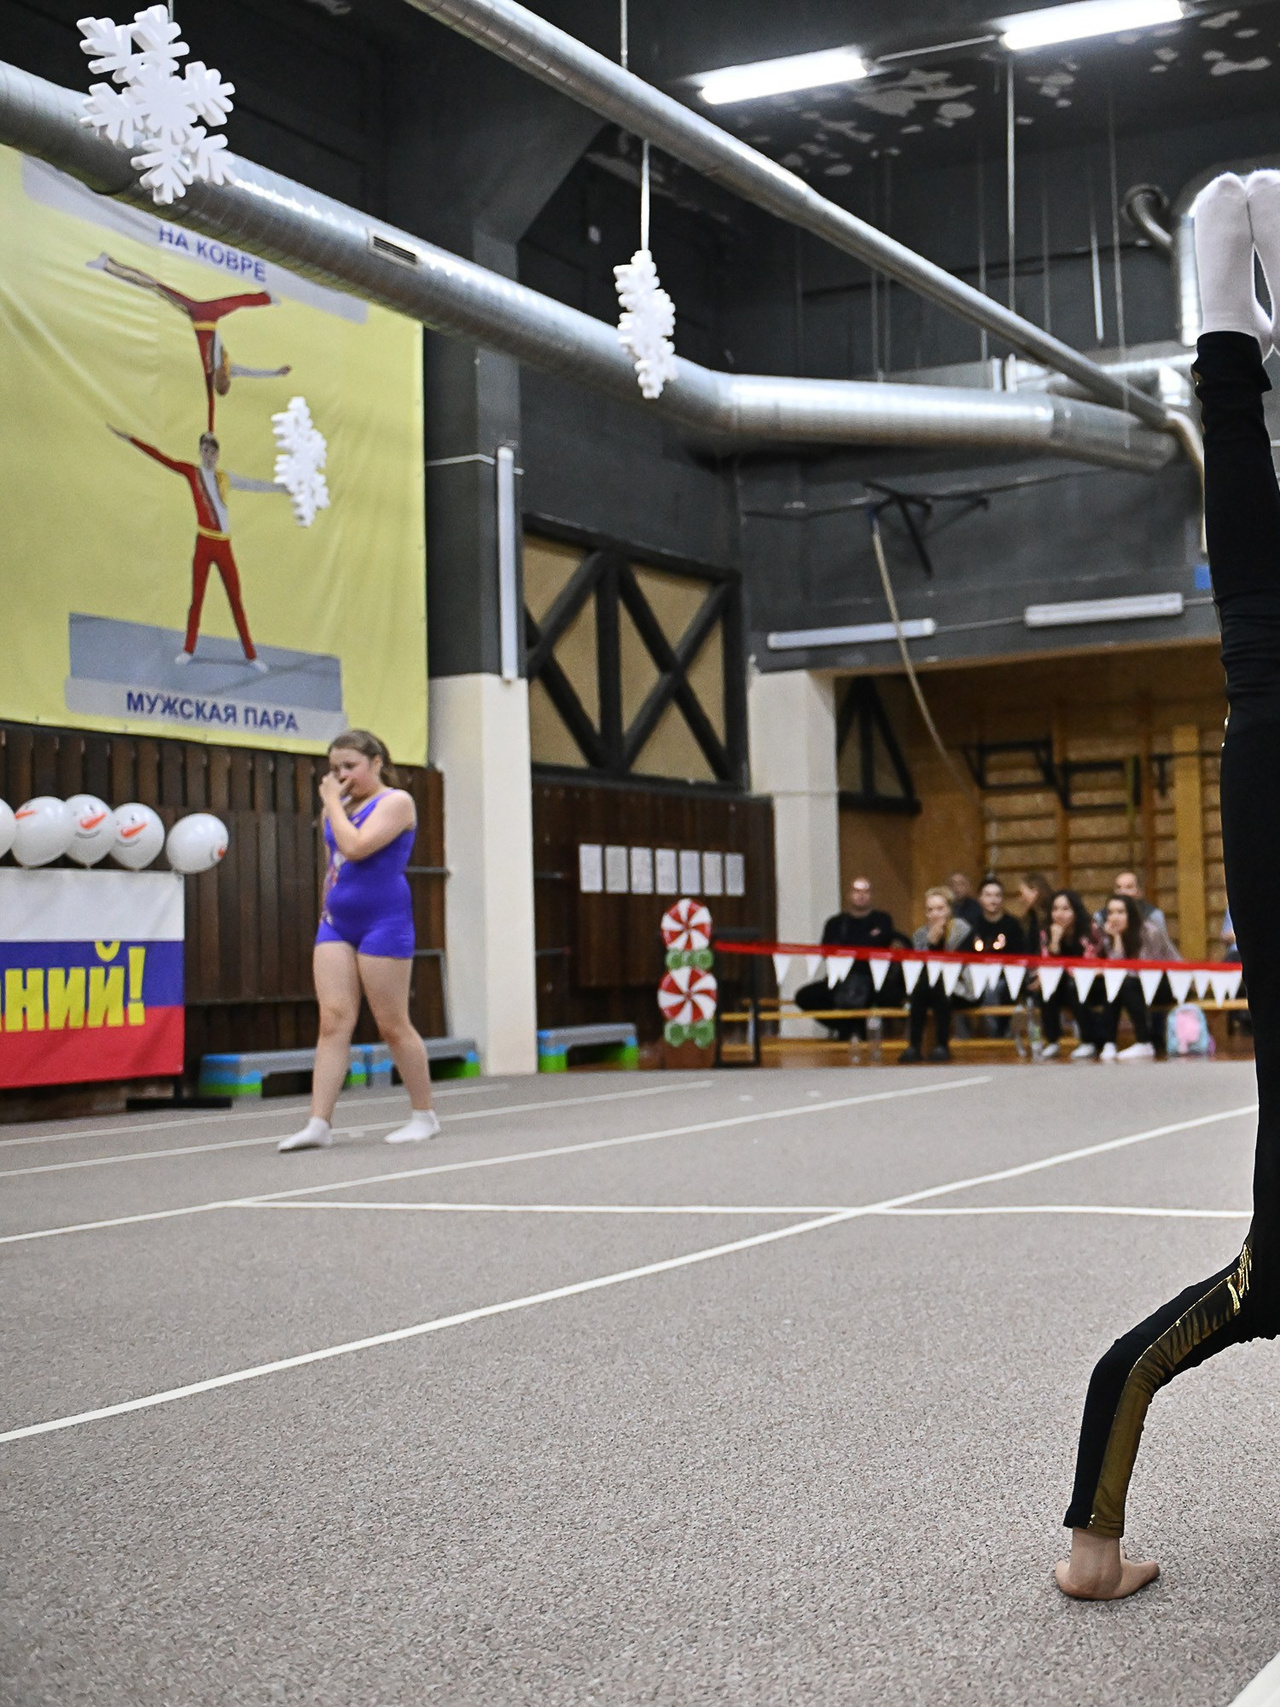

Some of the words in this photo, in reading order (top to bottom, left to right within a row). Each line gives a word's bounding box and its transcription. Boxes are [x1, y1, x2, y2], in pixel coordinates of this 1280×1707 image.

[159, 225, 189, 251] НА
[196, 240, 266, 283] КОВРЕ
[126, 690, 238, 725] МУЖСКАЯ
[244, 705, 299, 733] ПАРА
